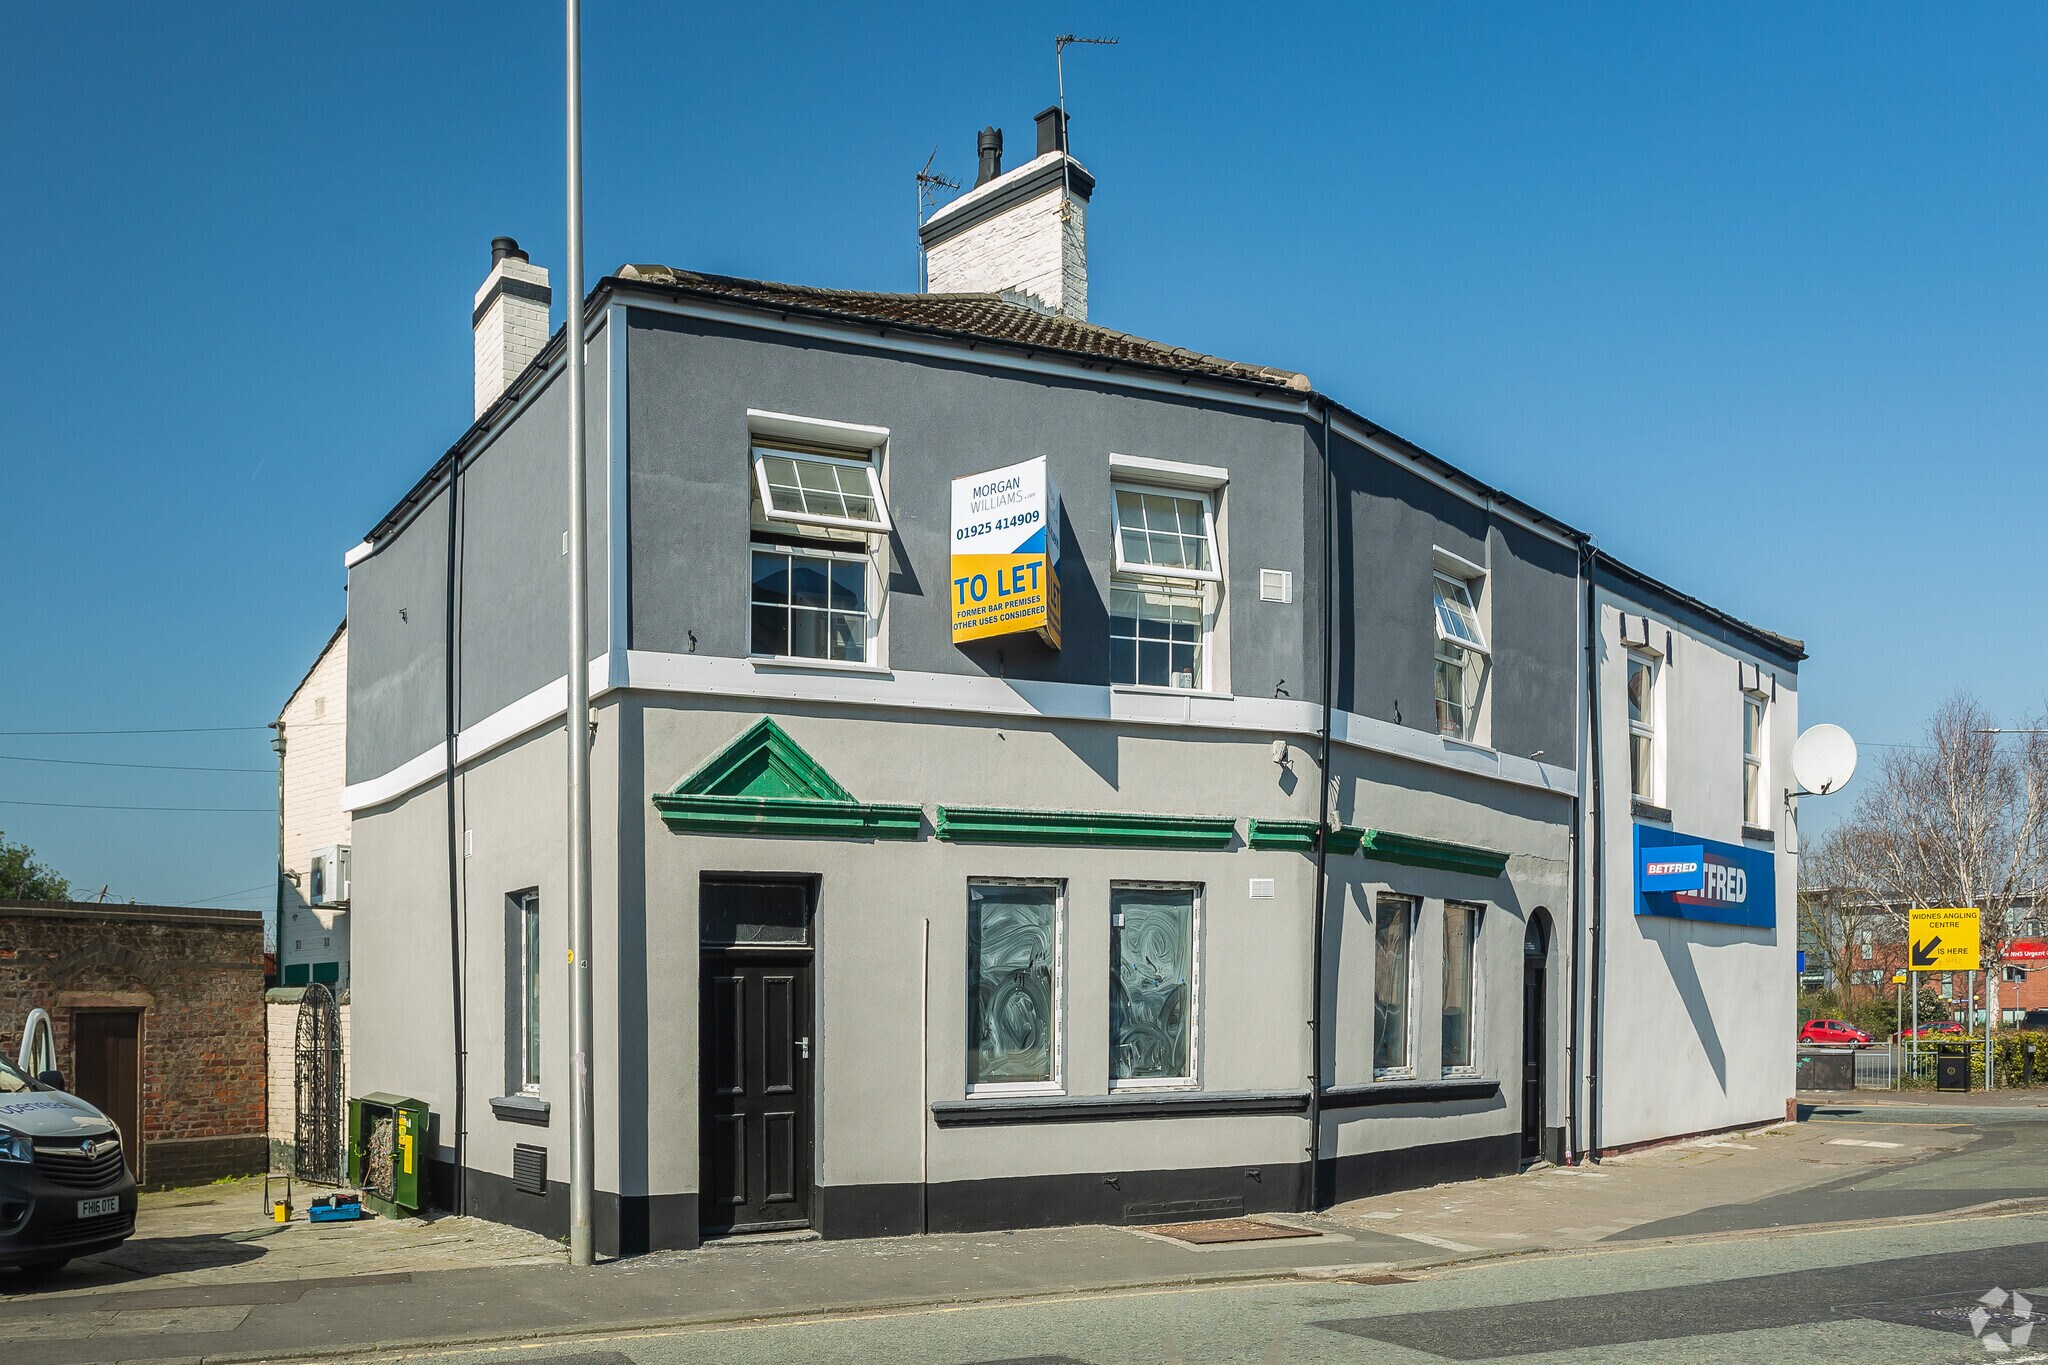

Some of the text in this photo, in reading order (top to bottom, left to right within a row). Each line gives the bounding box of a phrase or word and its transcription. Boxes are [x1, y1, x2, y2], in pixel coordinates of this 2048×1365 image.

[973, 476, 1020, 499] MORGAN
[956, 510, 1040, 541] 01925 414909
[954, 574, 988, 605] TO
[997, 560, 1043, 597] LET
[953, 620, 977, 631] OTHER
[979, 615, 998, 626] USES
[1000, 605, 1046, 622] CONSIDERED
[957, 594, 1041, 619] FORMER BAR PREMISES
[1648, 862, 1698, 874] BETFRED
[1676, 861, 1747, 904] TFRED
[1929, 921, 1960, 929] CENTRE
[1946, 947, 1969, 955] HERE
[82, 1200, 101, 1215] FH16
